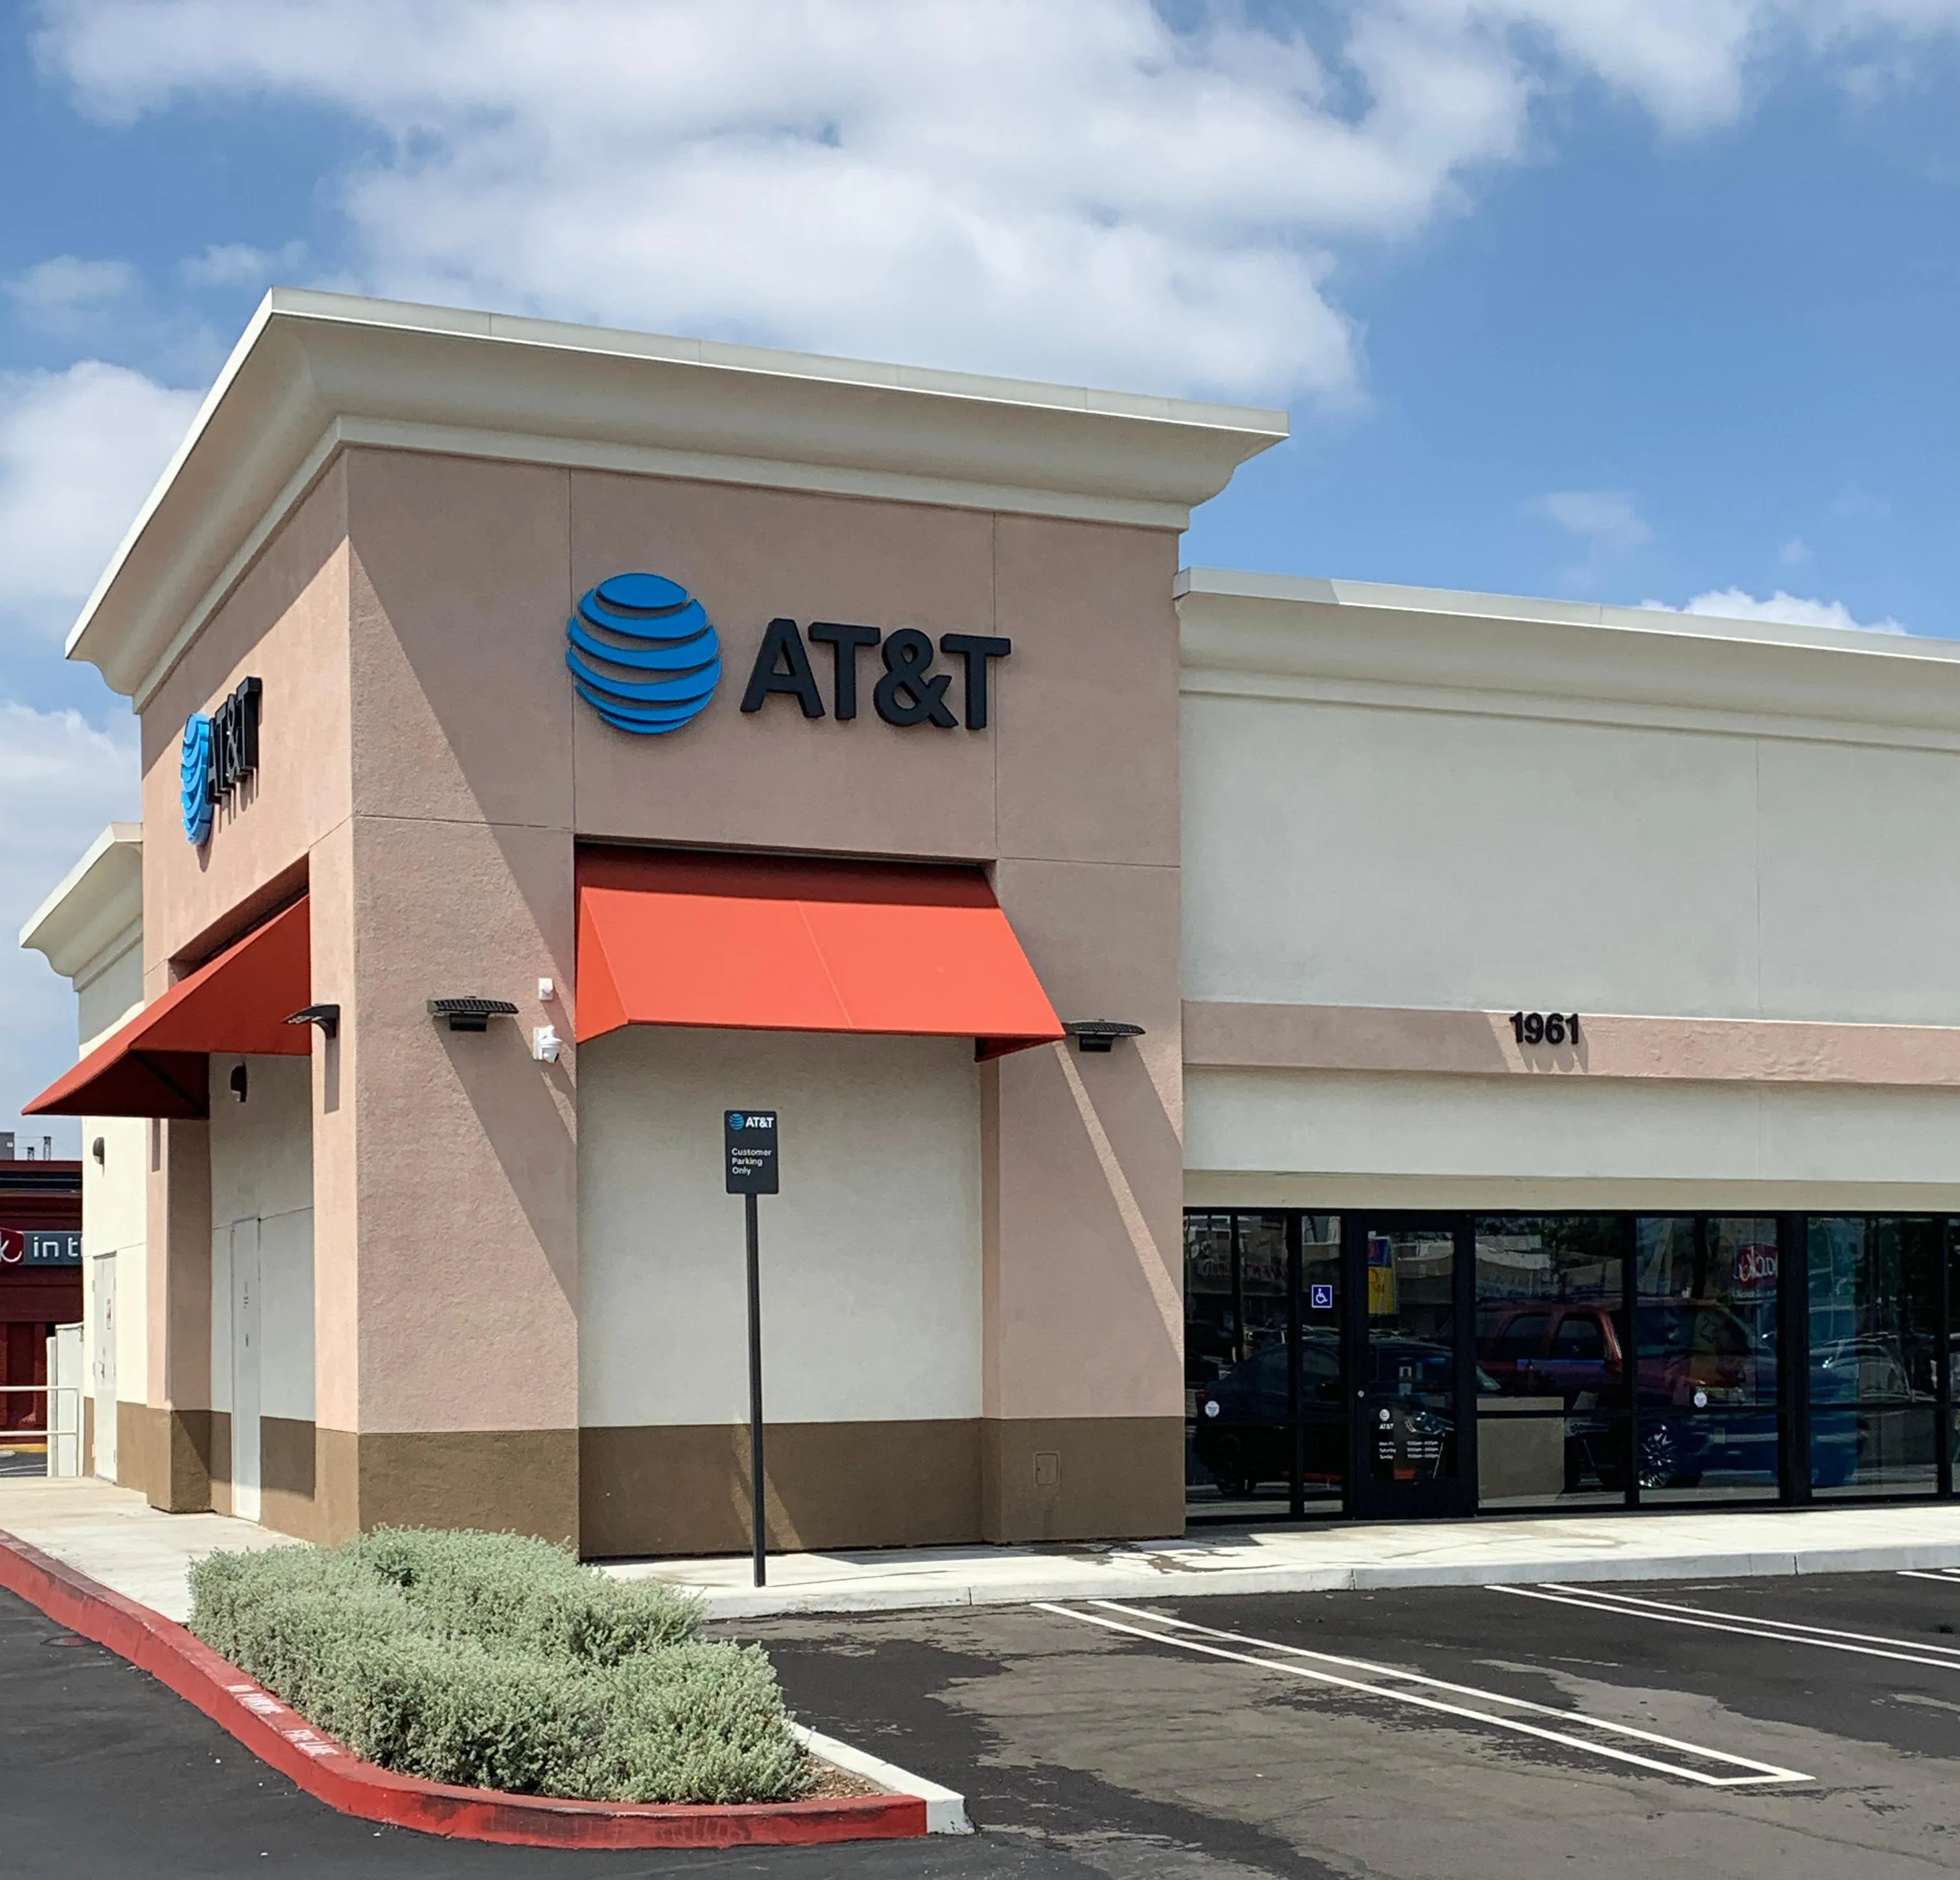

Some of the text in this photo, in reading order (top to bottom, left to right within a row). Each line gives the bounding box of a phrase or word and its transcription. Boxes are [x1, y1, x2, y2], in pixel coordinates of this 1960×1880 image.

[740, 618, 1011, 730] AT&T
[207, 676, 262, 805] AT&T
[1509, 1011, 1579, 1045] 1961
[745, 1116, 775, 1128] AT&T
[732, 1158, 763, 1166] Parking
[33, 1236, 59, 1257] in
